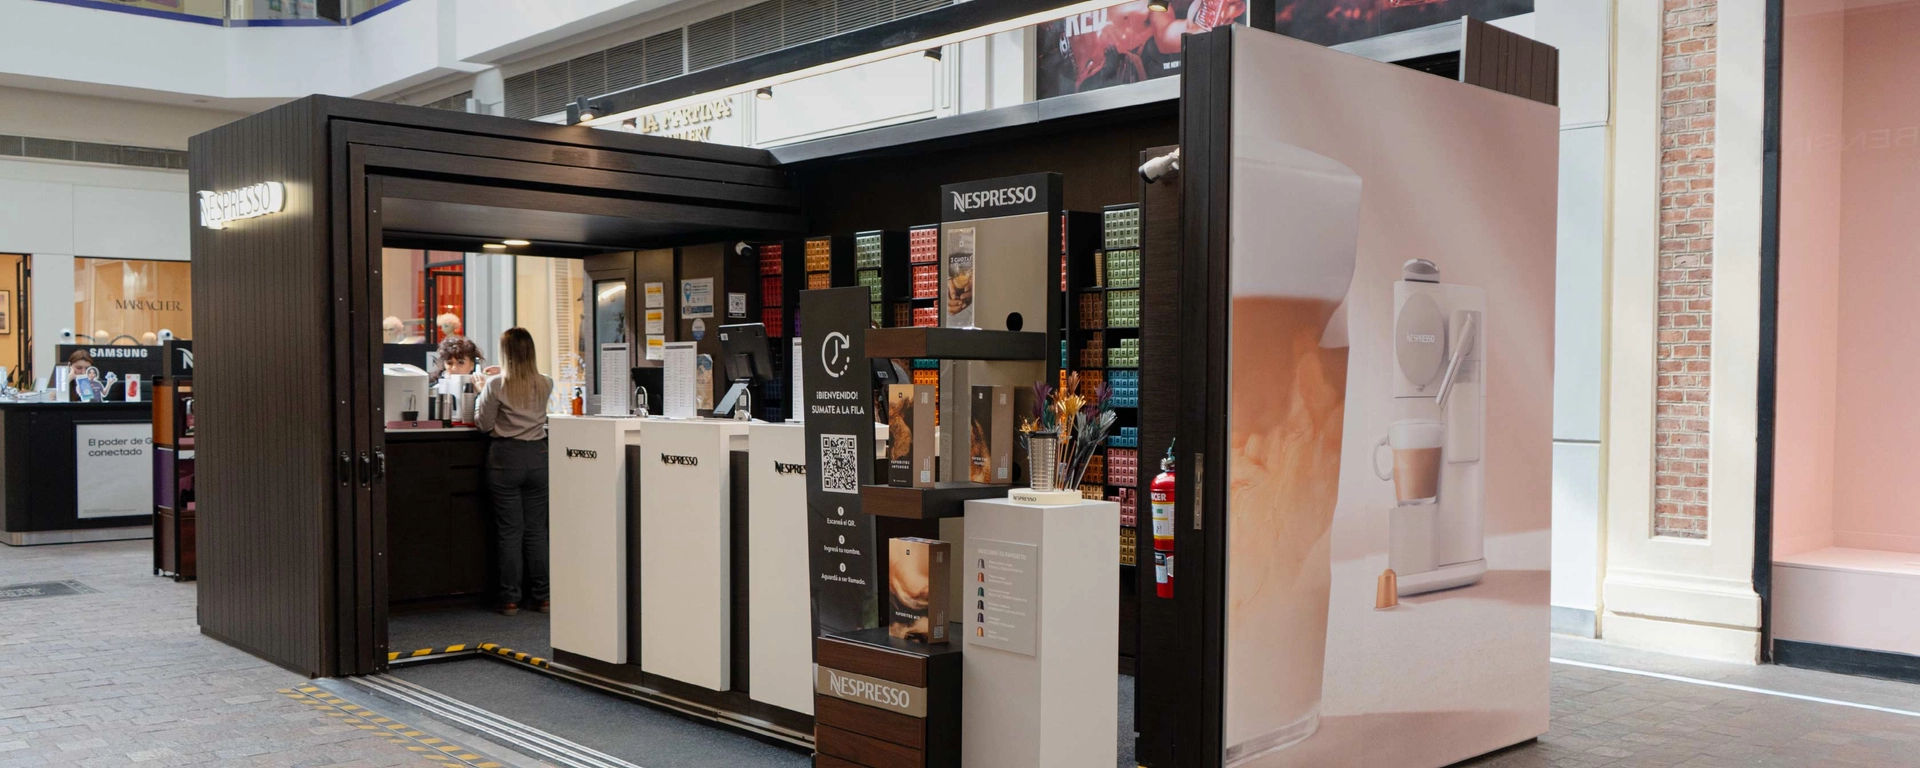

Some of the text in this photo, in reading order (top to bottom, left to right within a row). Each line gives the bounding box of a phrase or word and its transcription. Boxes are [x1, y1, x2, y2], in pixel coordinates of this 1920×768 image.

[641, 98, 731, 133] LA MARTINA
[950, 184, 1036, 213] NESPRESSO
[197, 182, 280, 230] NESPRESSO
[89, 348, 148, 358] SAMSUNG
[816, 391, 859, 400] ¡BIENVENIDO!
[811, 405, 865, 415] SUMATE A LA FILA
[88, 438, 96, 447] El
[98, 437, 128, 448] poder
[130, 437, 143, 445] de
[88, 448, 143, 457] conectado
[565, 447, 597, 459] NESPRESSO
[661, 453, 698, 466] NESPRESSO
[827, 669, 910, 708] NESPRESSO
